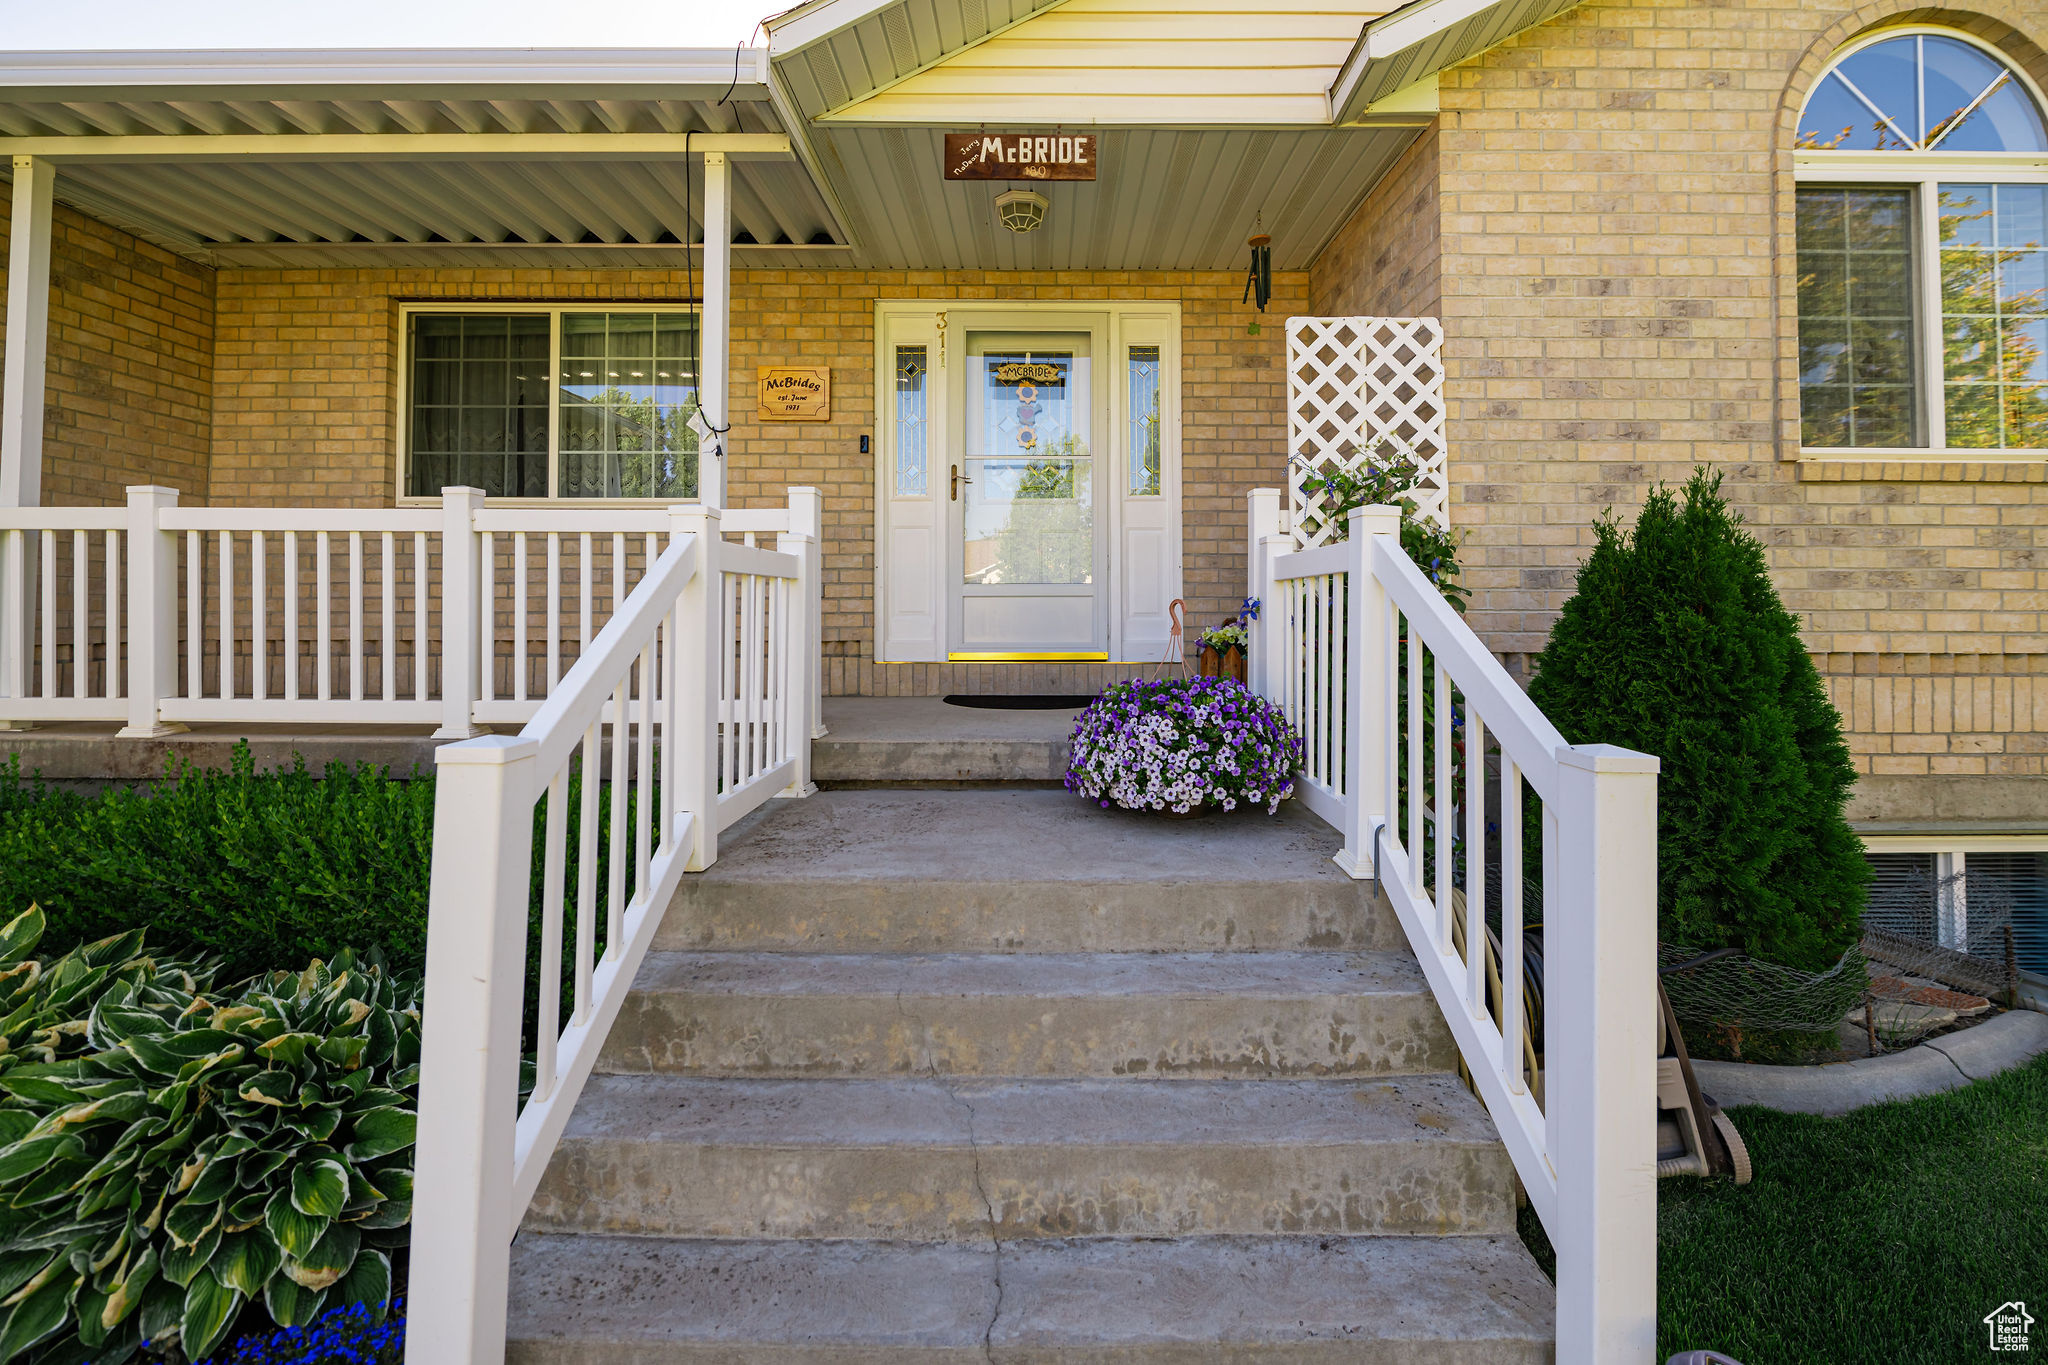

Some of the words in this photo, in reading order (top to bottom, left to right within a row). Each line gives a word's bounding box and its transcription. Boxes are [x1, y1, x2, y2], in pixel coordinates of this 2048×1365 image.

[960, 139, 980, 155] Jerry
[979, 137, 1088, 164] McBRIDE
[1006, 366, 1049, 378] MCBRIDE
[766, 377, 821, 391] McBrides
[777, 394, 790, 402] est.
[791, 394, 808, 402] June
